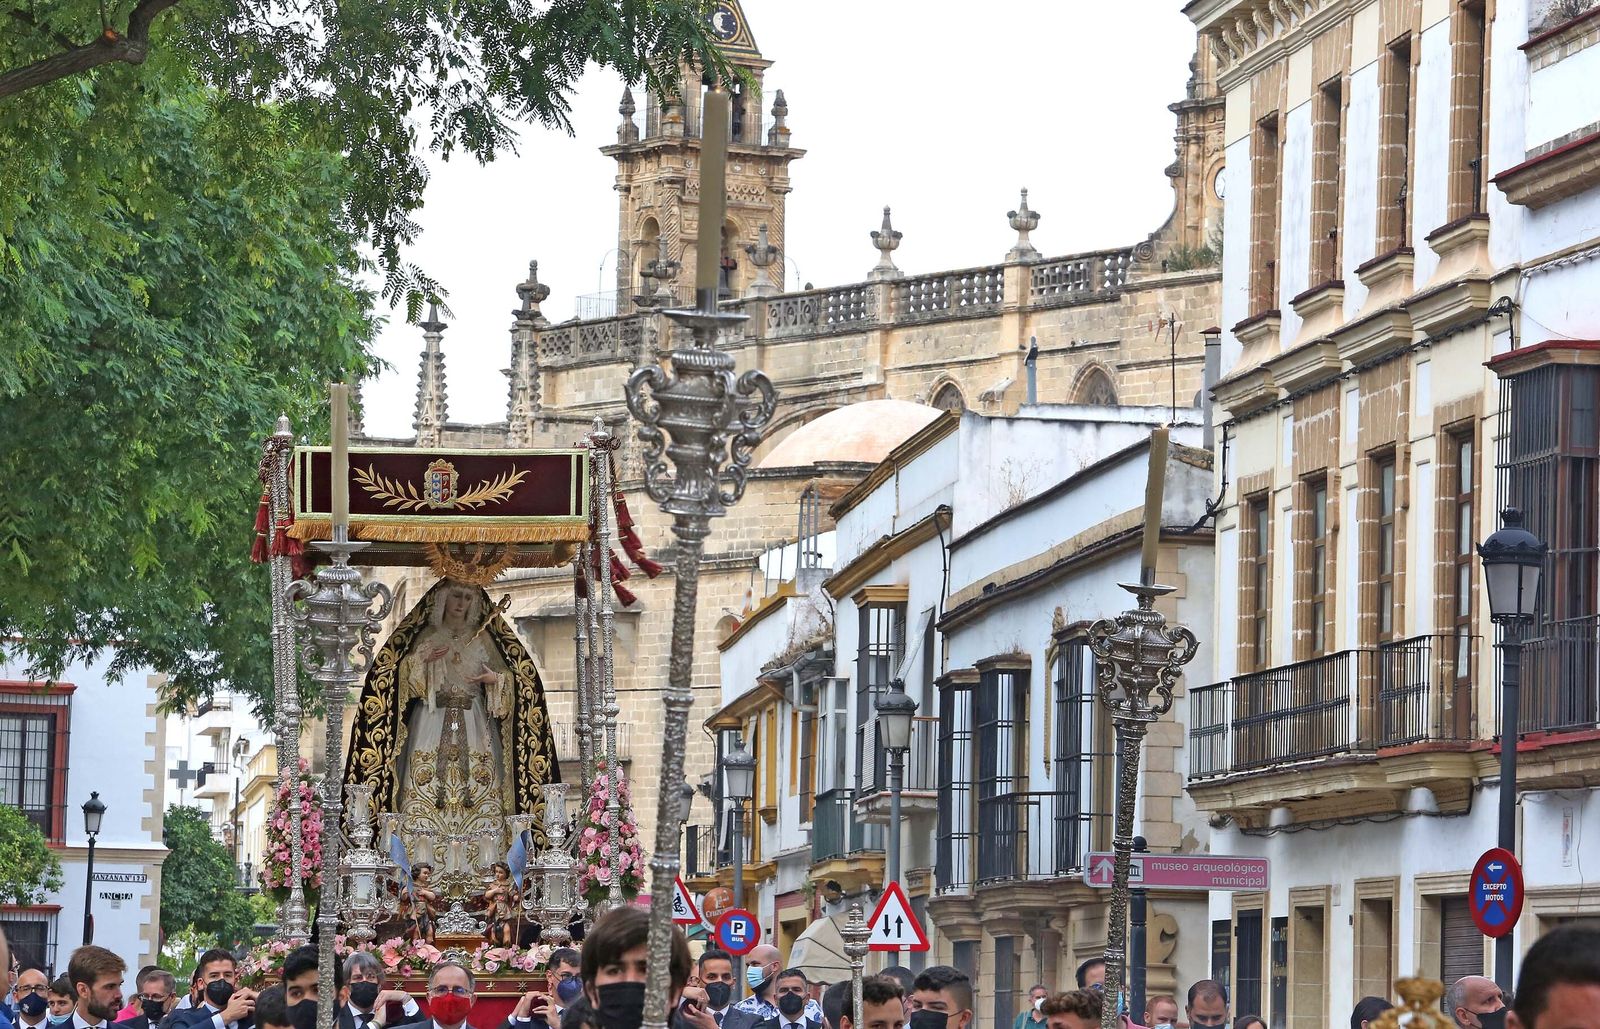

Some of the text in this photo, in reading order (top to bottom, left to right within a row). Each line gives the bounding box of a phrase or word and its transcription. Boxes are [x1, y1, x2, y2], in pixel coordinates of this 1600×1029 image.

[1151, 861, 1265, 875] museo arqueológico
[1212, 875, 1265, 887] municipal
[100, 892, 133, 900] ANCHA
[734, 922, 743, 933] P
